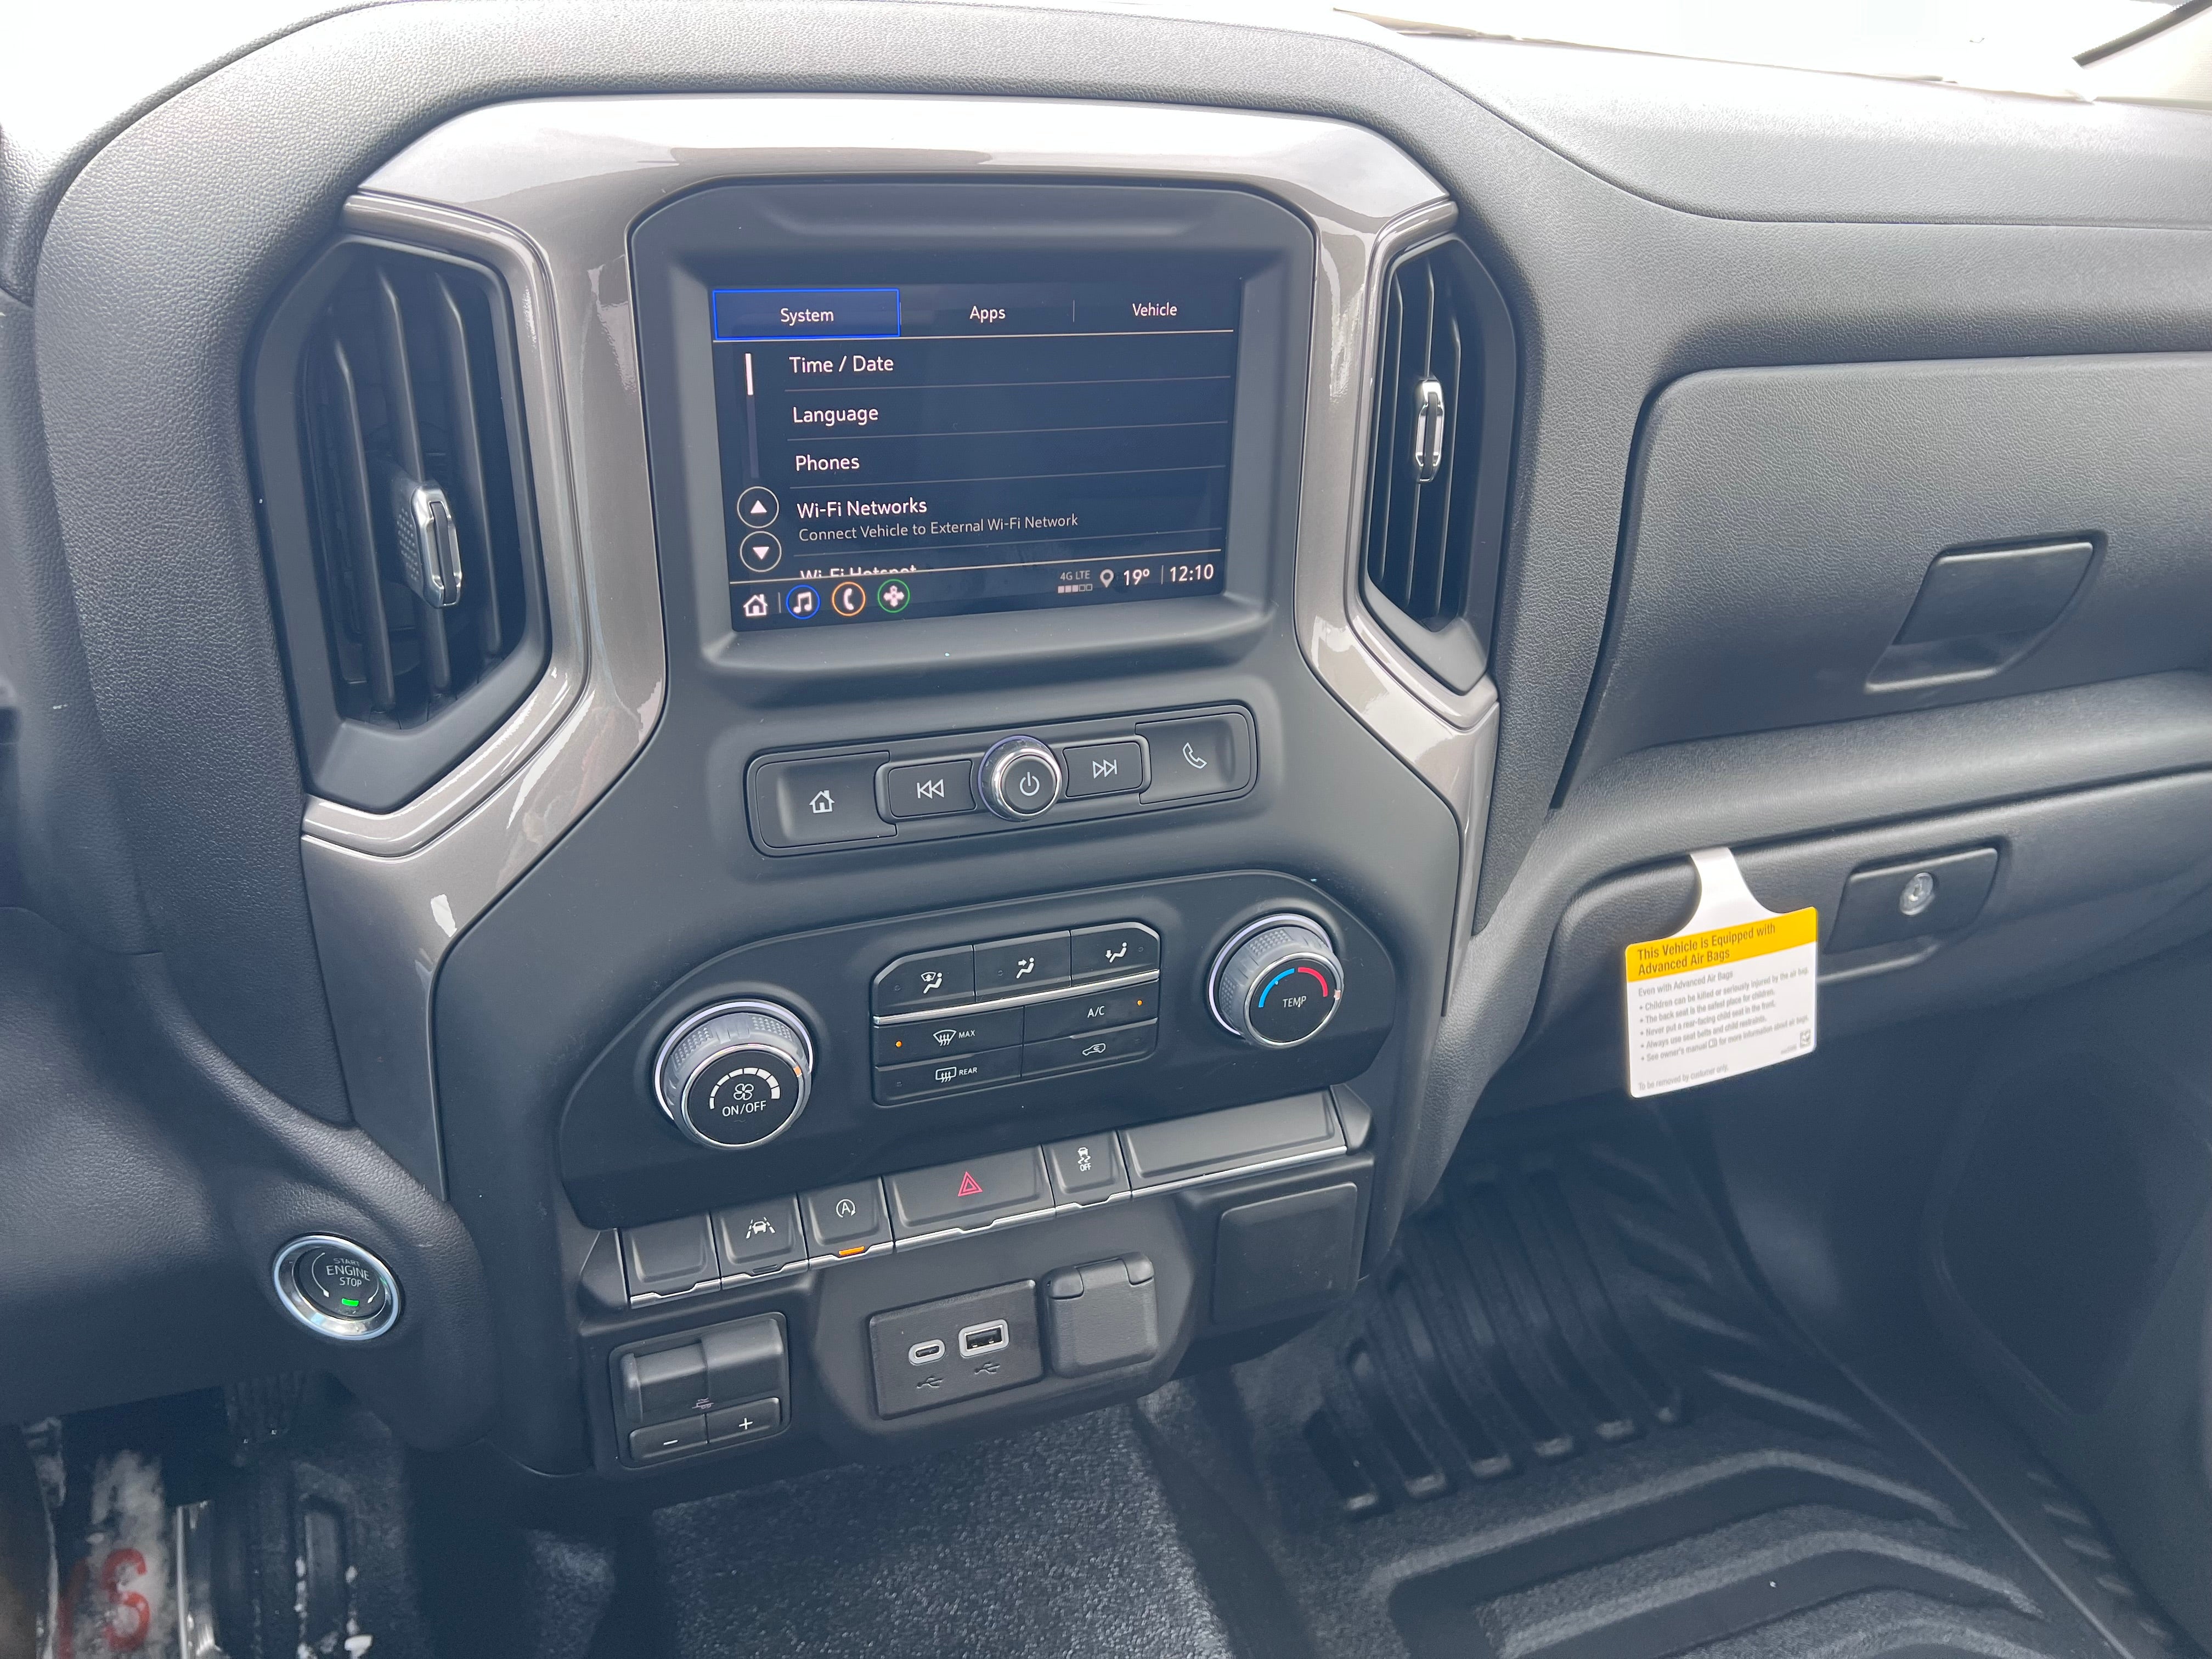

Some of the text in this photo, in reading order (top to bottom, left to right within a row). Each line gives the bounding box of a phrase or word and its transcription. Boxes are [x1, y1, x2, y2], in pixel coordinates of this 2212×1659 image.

[780, 308, 834, 326] System
[969, 305, 1006, 323] Apps
[1132, 302, 1178, 317] Vehicle
[789, 356, 833, 374] Time
[853, 355, 894, 372] Date
[793, 407, 878, 427] Language
[795, 455, 860, 471] Phones
[797, 496, 927, 519] Wi-Fi Networks
[799, 513, 1078, 541] Connect Vehicle to External Wi-Fi Network
[1060, 570, 1091, 581] 4G LTE
[1170, 563, 1214, 582] 12:10
[1638, 923, 1775, 960] This Vehicle is Equipped with
[1638, 949, 1730, 976] Advanced Air Bags
[1638, 970, 1733, 997] Even with Advanced Air Bags
[1283, 996, 1307, 1008] TEMP
[1645, 998, 1672, 1011] Children
[1674, 996, 1686, 1006] can
[1697, 989, 1714, 1000] killed
[1087, 1006, 1105, 1018] A/C
[1646, 1014, 1657, 1023] The
[958, 1029, 975, 1039] MAX
[1646, 1039, 1669, 1049] Always
[958, 1066, 978, 1076] REAR
[722, 1100, 766, 1117] ON/OFF
[1080, 1163, 1092, 1172] OFF
[333, 1257, 360, 1266] START
[326, 1265, 370, 1281] ENGINE
[339, 1277, 362, 1288] STOP
